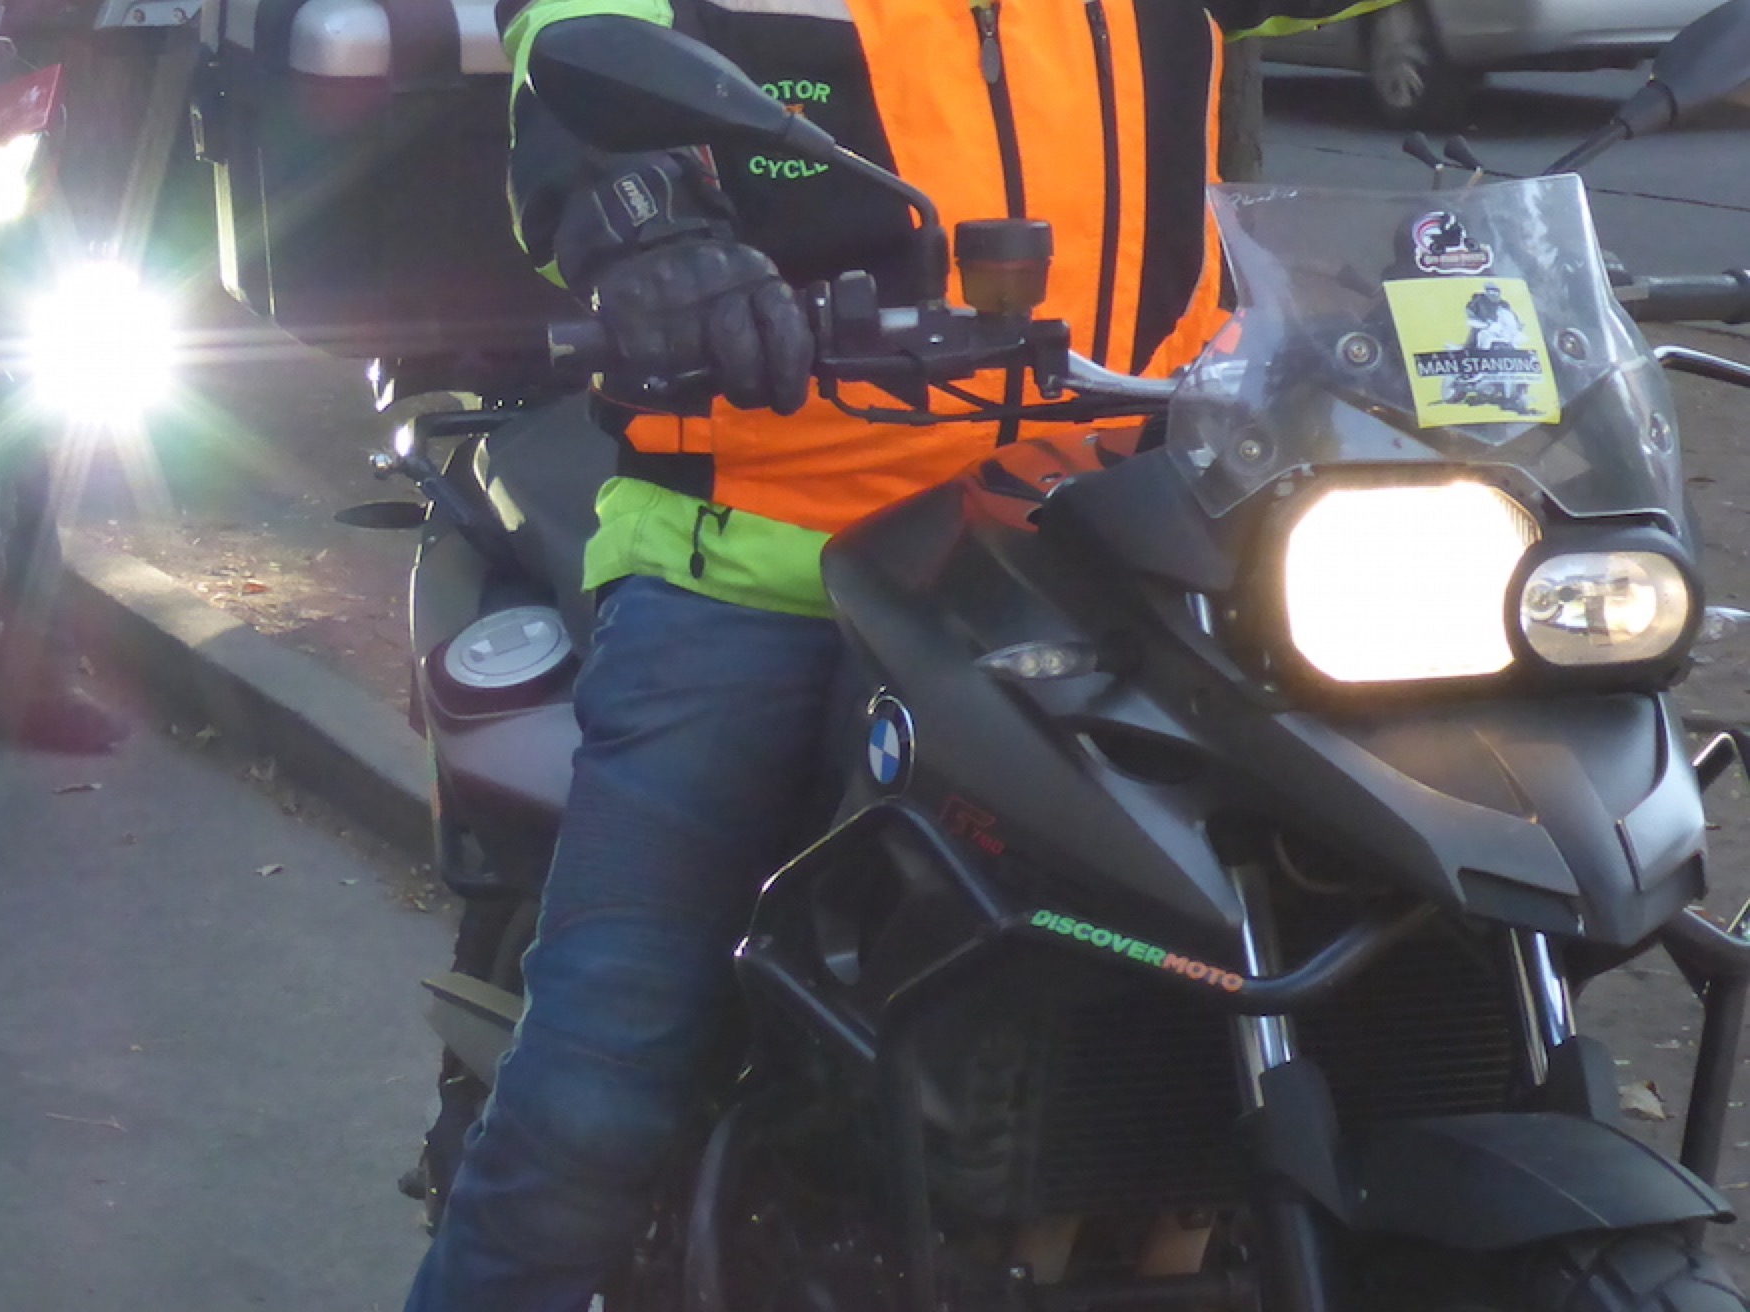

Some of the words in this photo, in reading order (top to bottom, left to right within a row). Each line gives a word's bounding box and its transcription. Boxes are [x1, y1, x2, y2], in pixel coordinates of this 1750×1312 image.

[761, 79, 831, 103] OTOR
[1416, 358, 1459, 376] MAN
[1461, 357, 1541, 374] STANDING
[1030, 908, 1246, 993] DISCOVERMOTO
